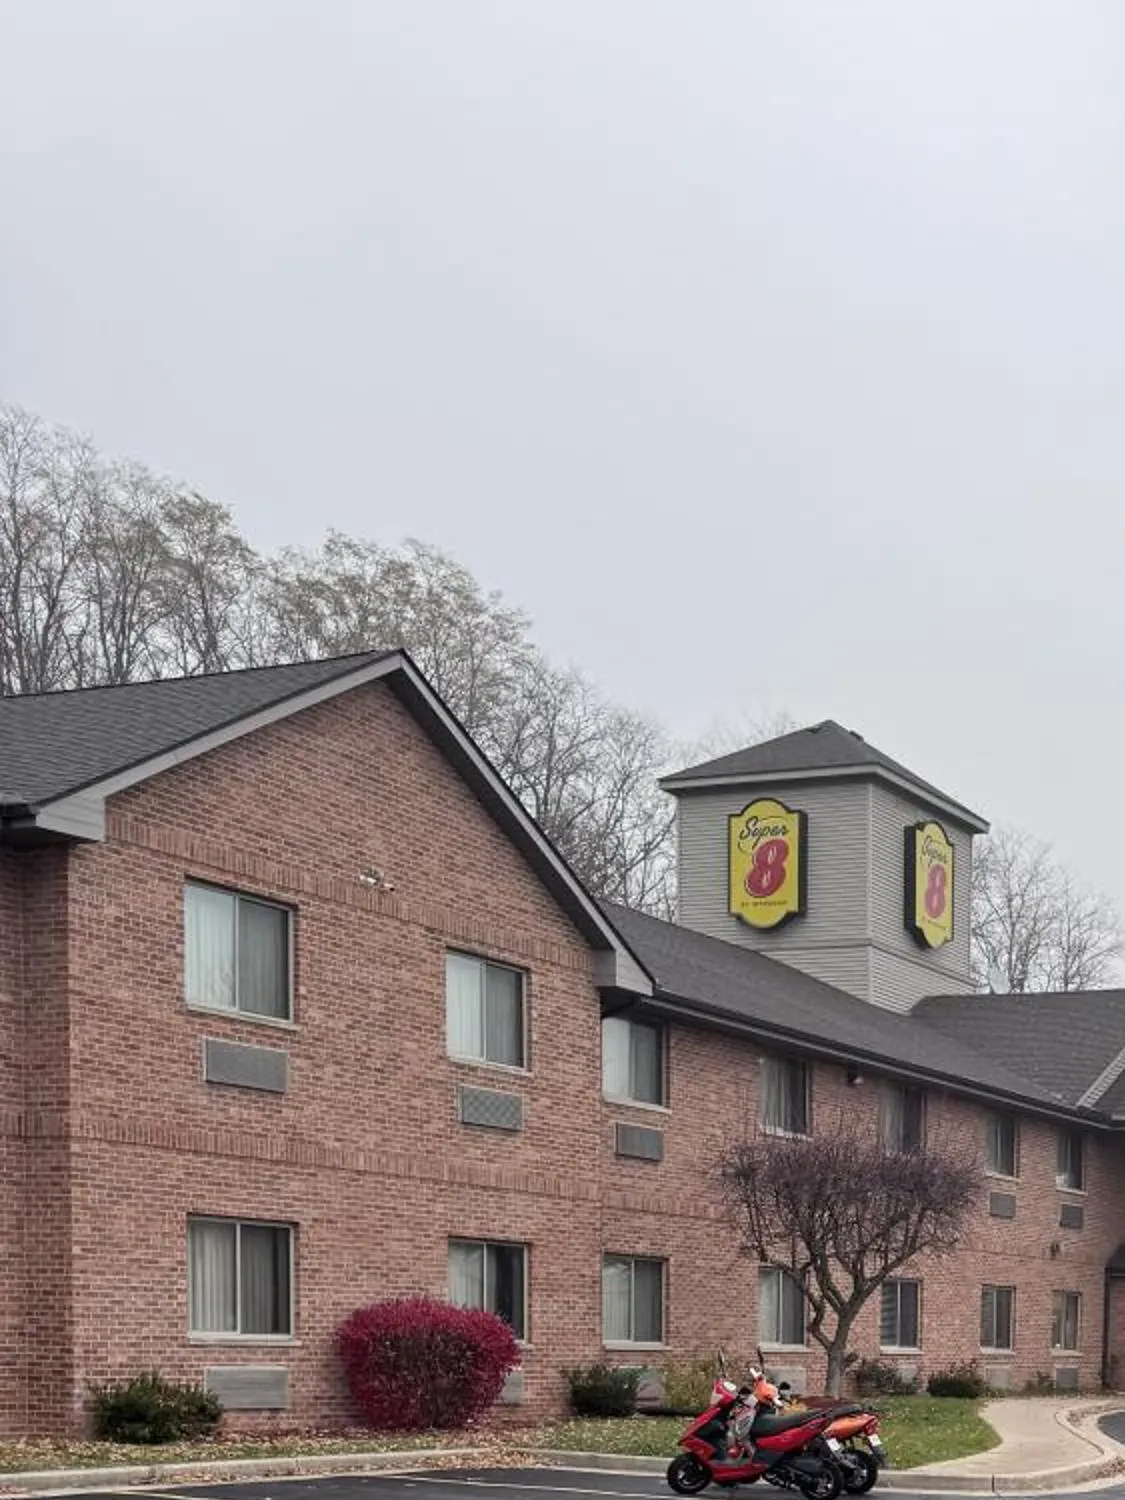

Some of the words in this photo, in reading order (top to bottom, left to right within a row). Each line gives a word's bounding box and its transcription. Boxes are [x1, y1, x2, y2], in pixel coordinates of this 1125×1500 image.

[738, 815, 788, 853] Super
[744, 838, 789, 898] 8
[925, 863, 947, 919] 8
